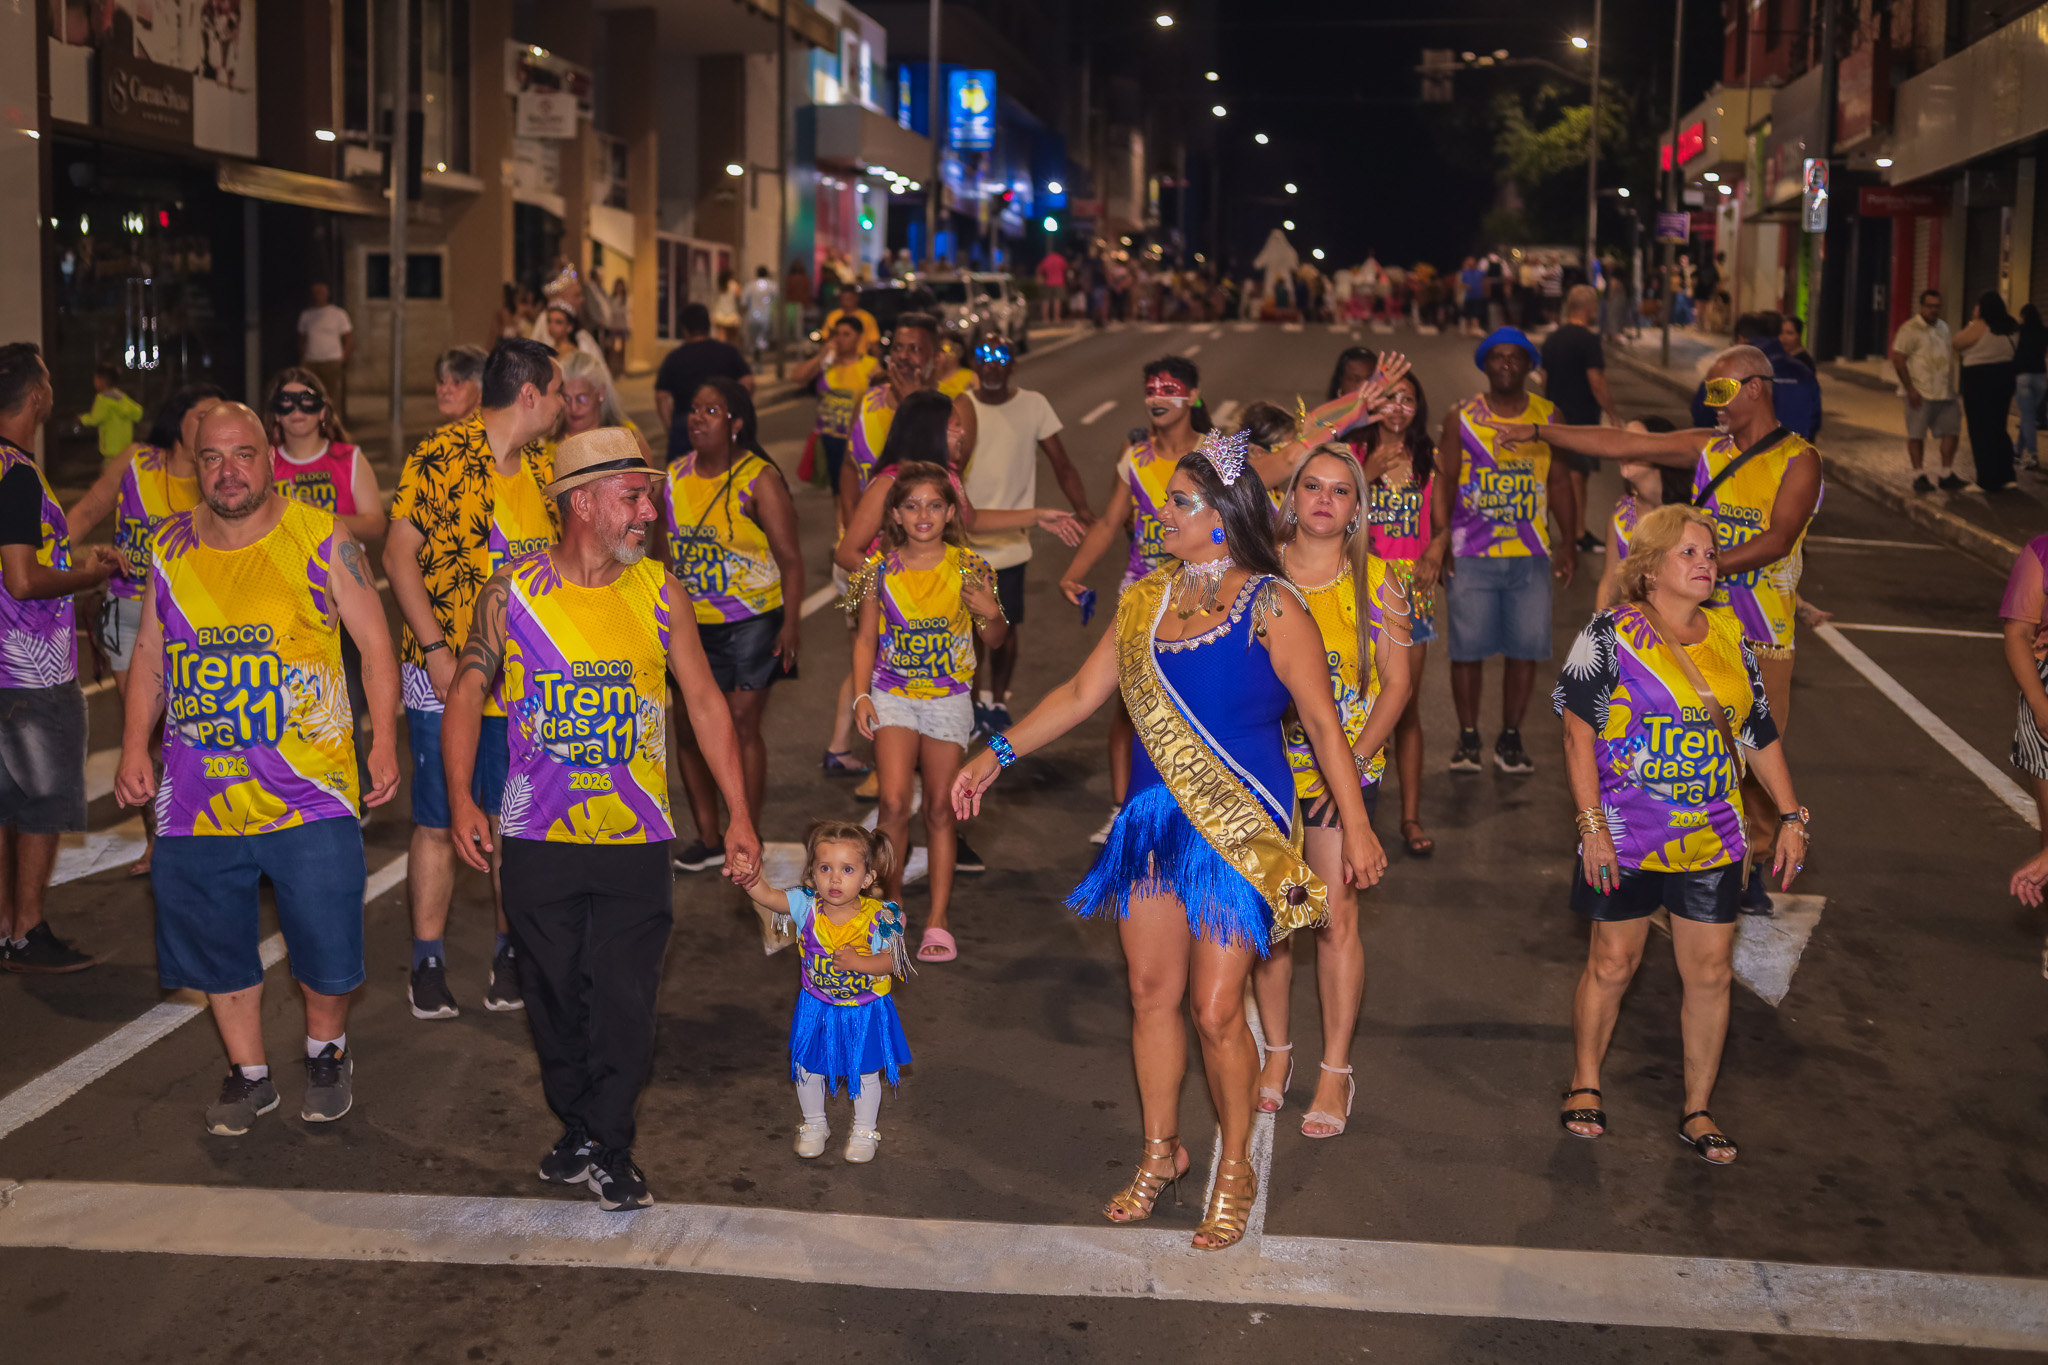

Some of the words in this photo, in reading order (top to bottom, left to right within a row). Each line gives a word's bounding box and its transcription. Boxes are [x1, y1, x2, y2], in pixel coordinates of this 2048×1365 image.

[273, 479, 336, 501] Trem
[1476, 467, 1536, 493] Trem
[1370, 485, 1424, 511] Trem
[1479, 494, 1508, 507] das
[1510, 492, 1534, 520] 11
[1399, 510, 1420, 536] 11
[1719, 504, 1762, 521] BLOCO
[124, 518, 154, 551] Tre
[1141, 514, 1166, 540] Tre
[1384, 523, 1402, 538] PG
[694, 561, 723, 592] 11
[199, 626, 272, 646] BLOCO
[908, 617, 949, 630] BLOCO
[890, 625, 951, 654] Trem
[166, 642, 279, 690] Trem
[573, 662, 632, 677] BLOCO
[892, 652, 921, 666] das
[924, 651, 952, 678] 11
[534, 673, 637, 716] Trem
[173, 693, 218, 719] das
[223, 688, 277, 741] 11
[1682, 707, 1734, 722] BLOO
[198, 721, 235, 746] PG
[543, 717, 590, 740] das
[595, 715, 633, 760] 11
[569, 742, 602, 764] PG
[202, 755, 250, 778] 2026
[1643, 758, 1695, 779] das
[1700, 757, 1732, 797] 11
[568, 772, 613, 791] 2026
[1150, 717, 1178, 746] DO
[1173, 745, 1266, 851] CARNAVAL
[1672, 783, 1704, 804] PG
[1668, 810, 1710, 827] 2026
[815, 974, 840, 986] das
[831, 988, 851, 999] PG
